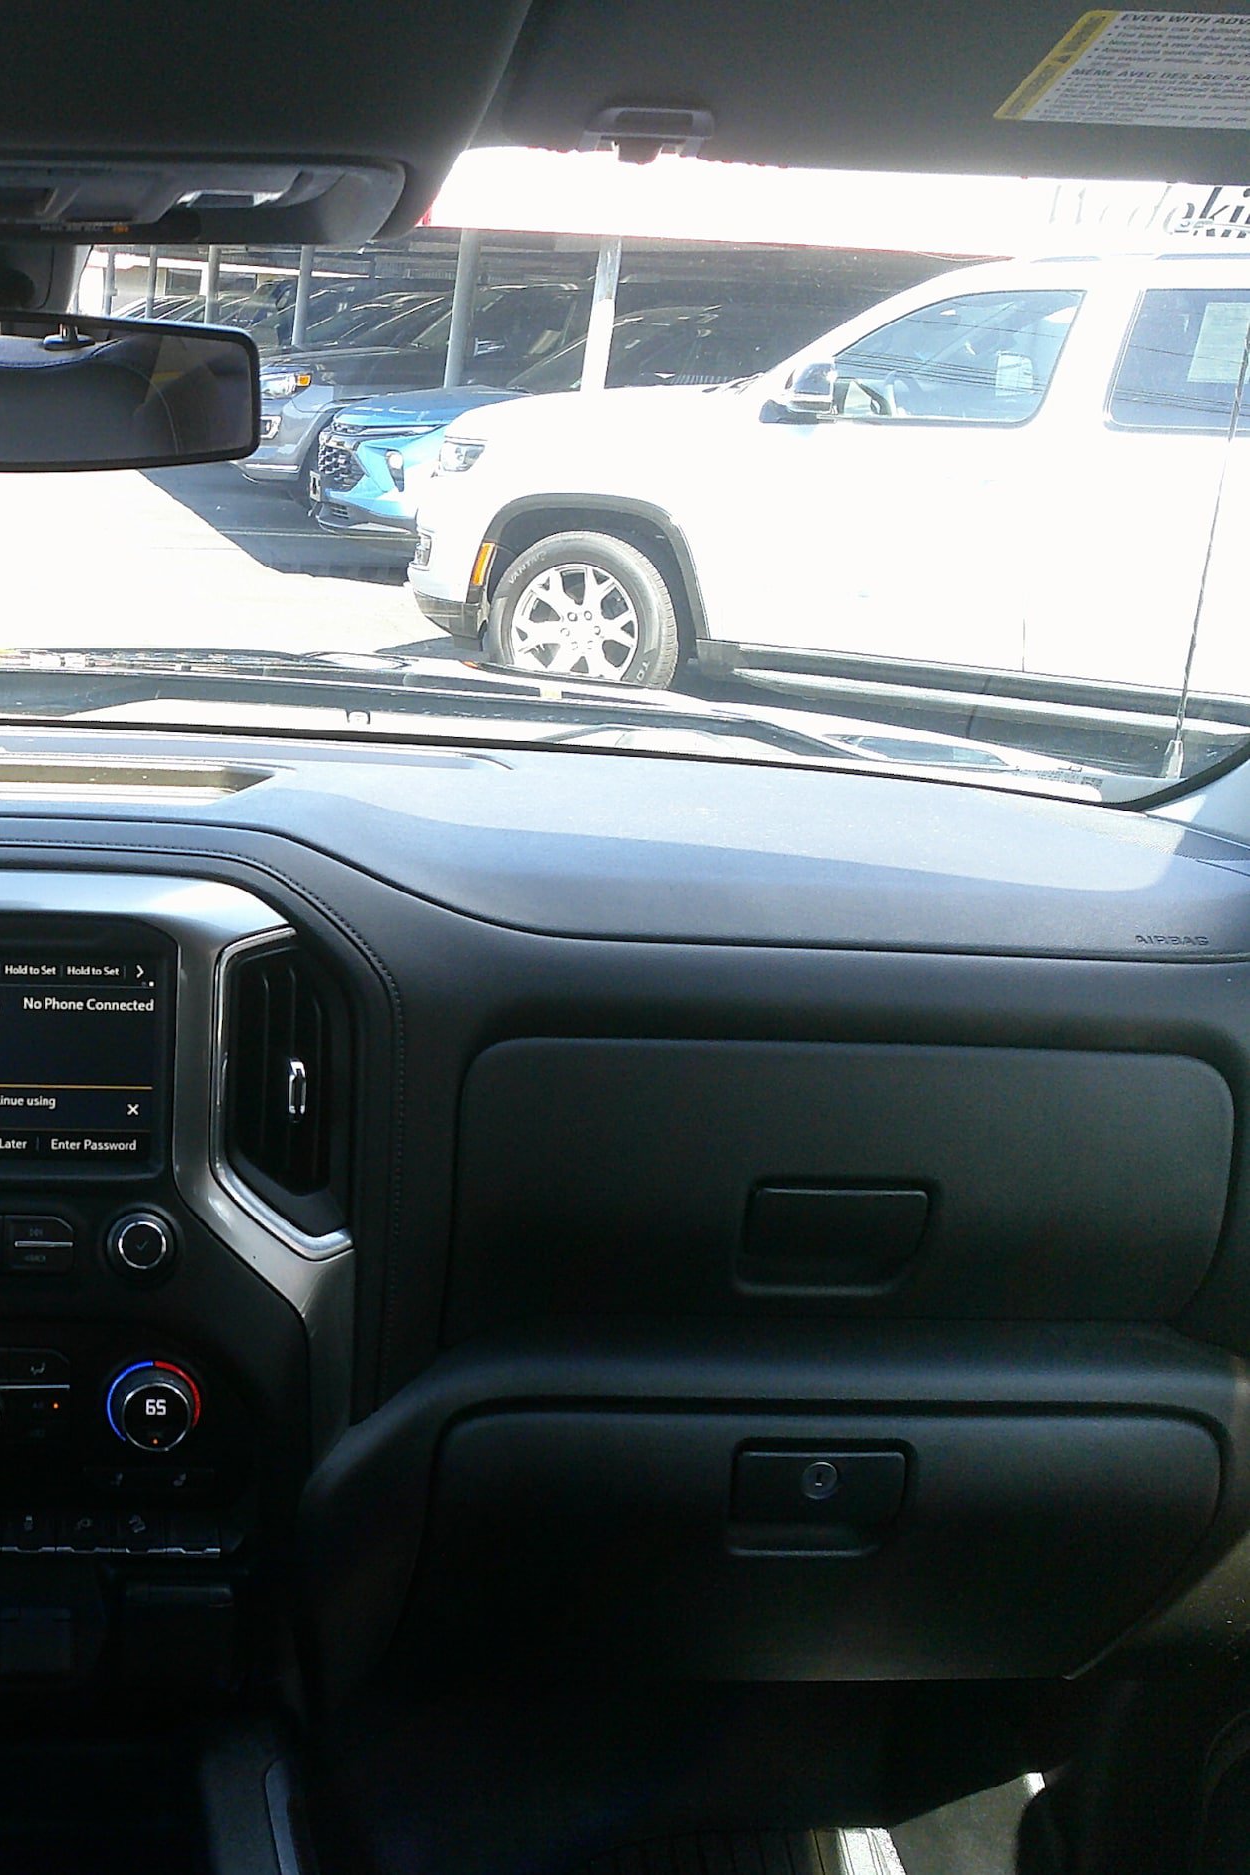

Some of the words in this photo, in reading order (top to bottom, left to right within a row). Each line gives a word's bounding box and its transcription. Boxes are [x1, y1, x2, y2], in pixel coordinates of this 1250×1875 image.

[1135, 935, 1209, 946] AIRBAG
[5, 964, 28, 975] Hold
[29, 966, 40, 975] to
[41, 965, 56, 975] Set
[67, 965, 91, 976] Hold
[92, 967, 102, 976] to
[103, 966, 119, 976] Set
[23, 997, 42, 1010] No
[44, 997, 84, 1010] Phone
[86, 999, 154, 1012] Connected
[26, 1095, 56, 1110] using
[0, 1138, 28, 1149] Later
[51, 1138, 81, 1150] Enter
[83, 1139, 137, 1151] Password
[144, 1398, 168, 1416] 65
